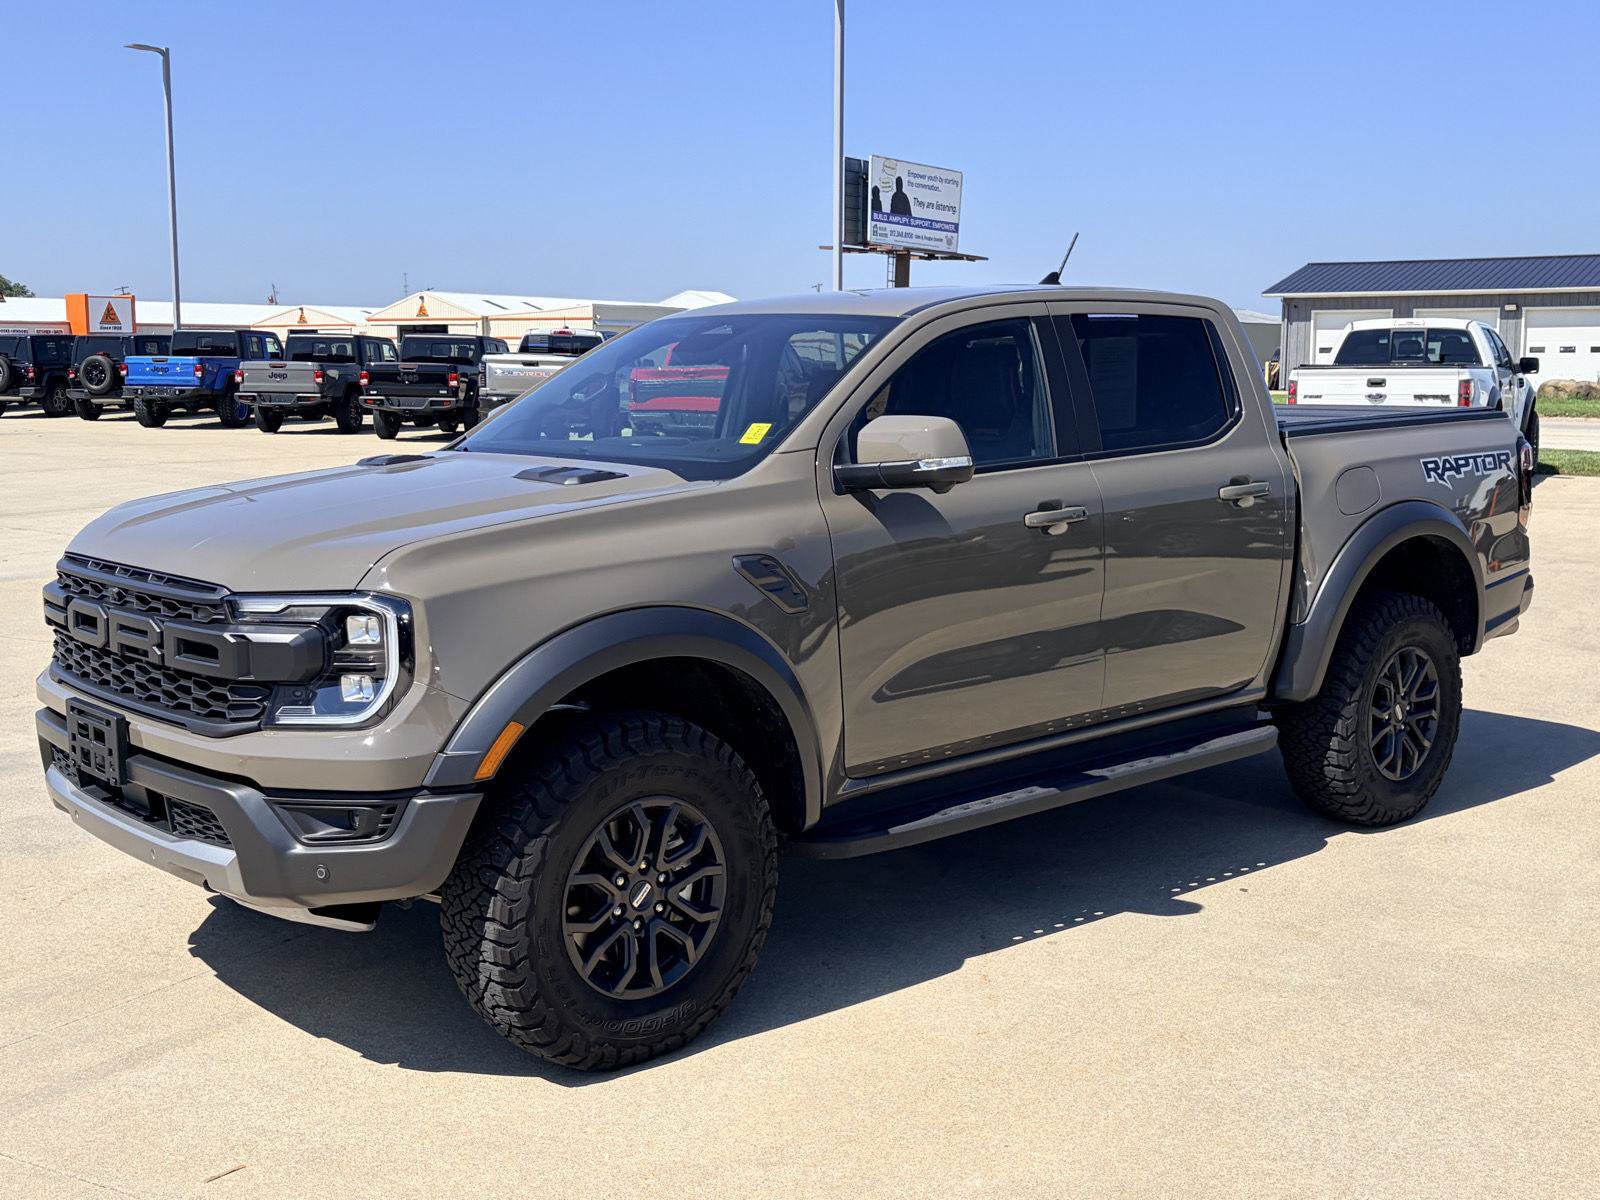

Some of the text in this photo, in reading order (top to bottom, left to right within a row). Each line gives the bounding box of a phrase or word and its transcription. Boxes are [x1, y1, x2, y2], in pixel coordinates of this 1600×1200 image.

[907, 170, 927, 179] Empower
[944, 178, 959, 187] starting
[913, 197, 925, 209] They
[873, 213, 888, 221] BUILD.
[889, 216, 909, 225] AMPLIFY.
[910, 219, 931, 228] SUPPORT.
[151, 365, 169, 374] Jeep
[268, 371, 287, 380] Jeep
[396, 372, 419, 383] Jeep
[1420, 450, 1517, 490] RAPTOR
